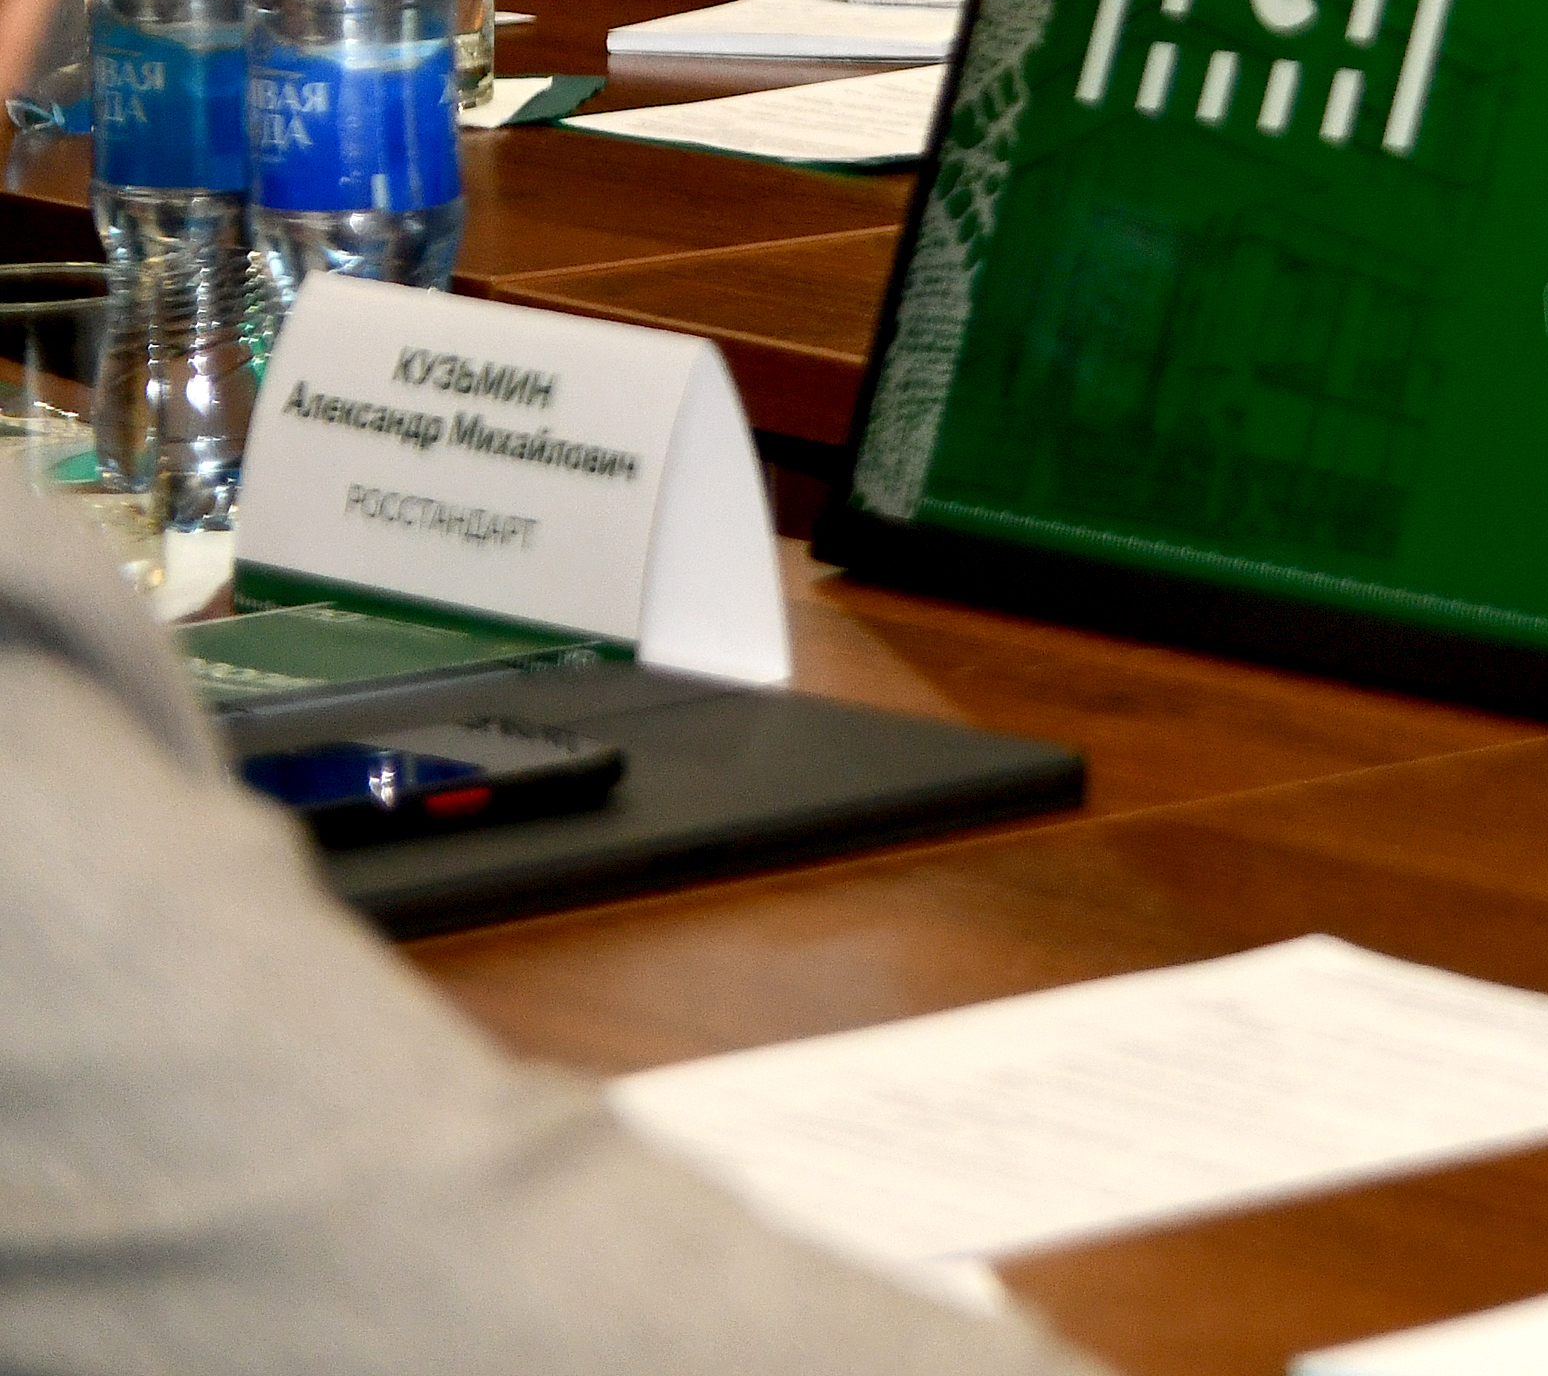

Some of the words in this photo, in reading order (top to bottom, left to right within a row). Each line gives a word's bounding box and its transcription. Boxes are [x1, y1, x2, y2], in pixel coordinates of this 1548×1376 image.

[392, 344, 559, 411] КУЗЬМИН
[281, 379, 443, 453] Александр
[447, 407, 640, 481] Михайлович
[344, 482, 541, 550] РОССТАНДАРТ
